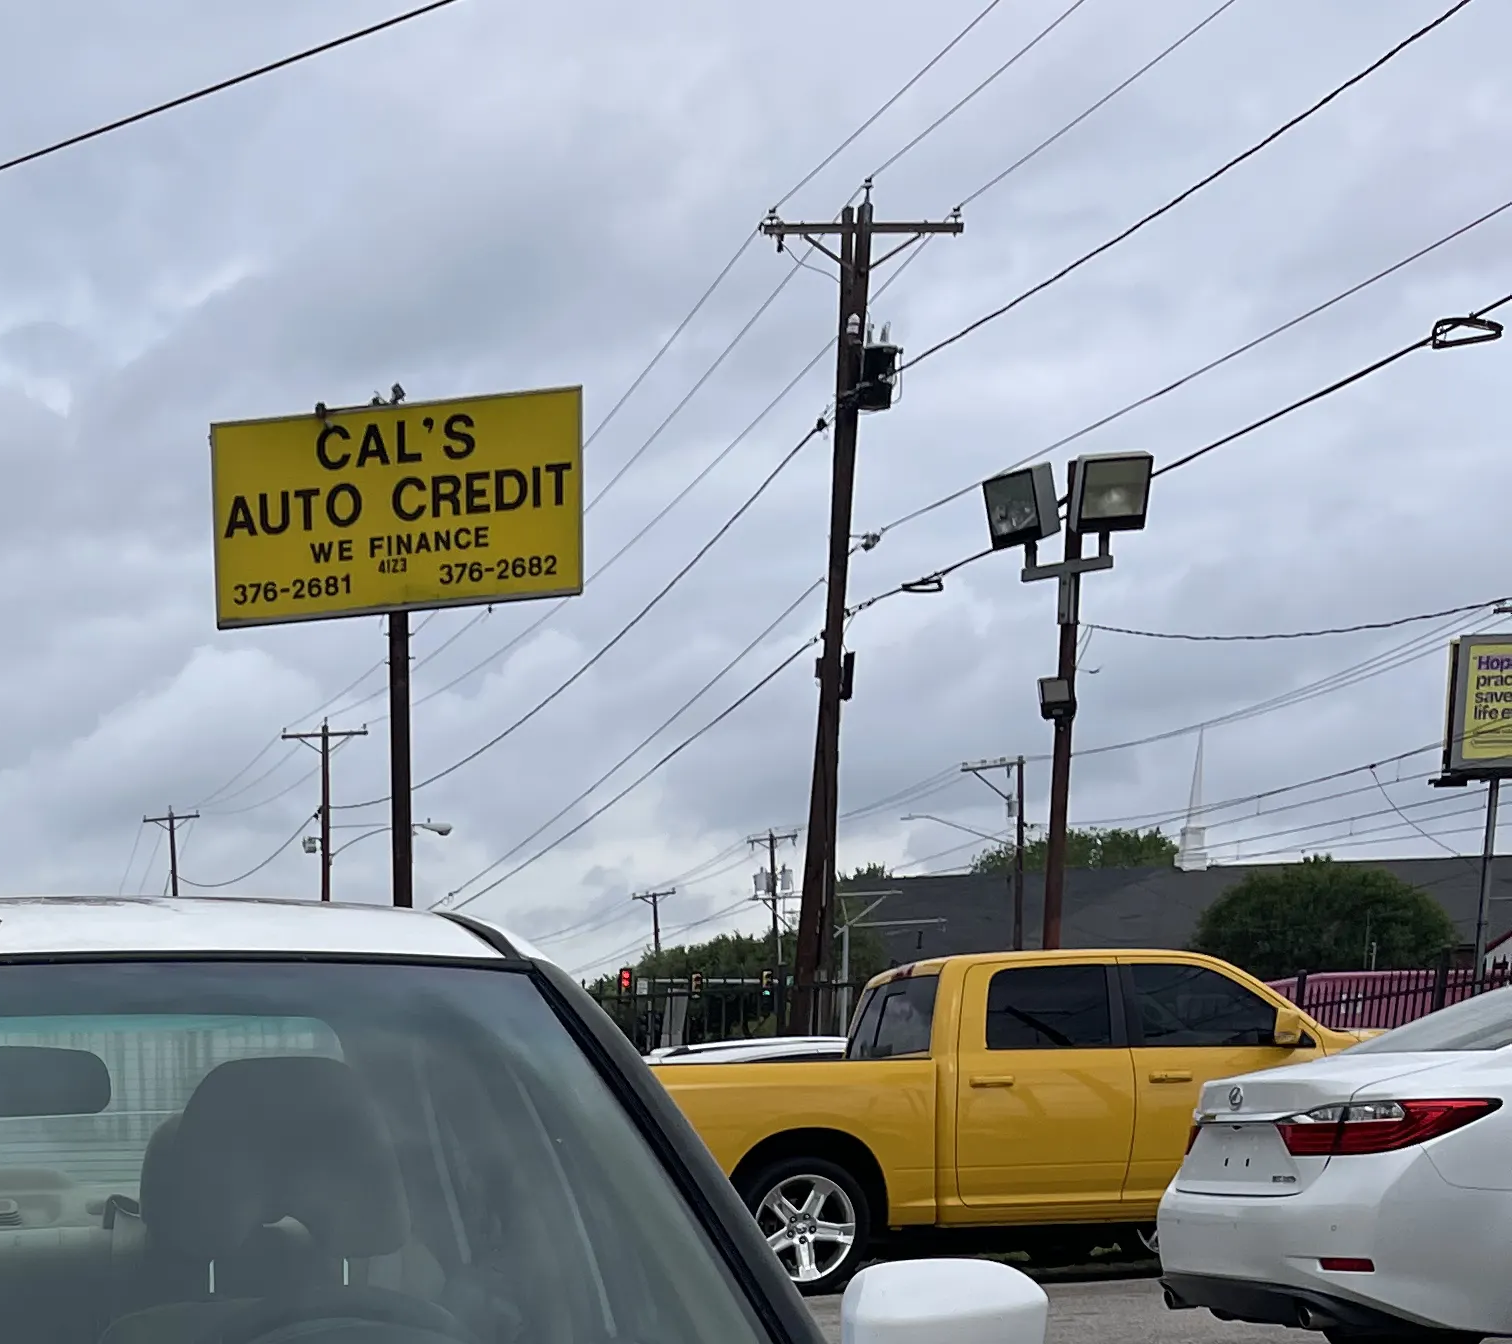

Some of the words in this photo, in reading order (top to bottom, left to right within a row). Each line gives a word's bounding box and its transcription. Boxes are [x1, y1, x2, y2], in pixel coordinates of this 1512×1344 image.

[316, 413, 476, 470] CAL'S
[224, 482, 363, 539] AUTO
[391, 462, 573, 522] CREDIT
[310, 539, 354, 564] WE
[369, 526, 489, 558] FINANCE
[378, 557, 407, 574] 4123
[233, 574, 352, 605] 376-2681
[439, 554, 558, 586] 376-2682
[1477, 656, 1512, 672] Hop
